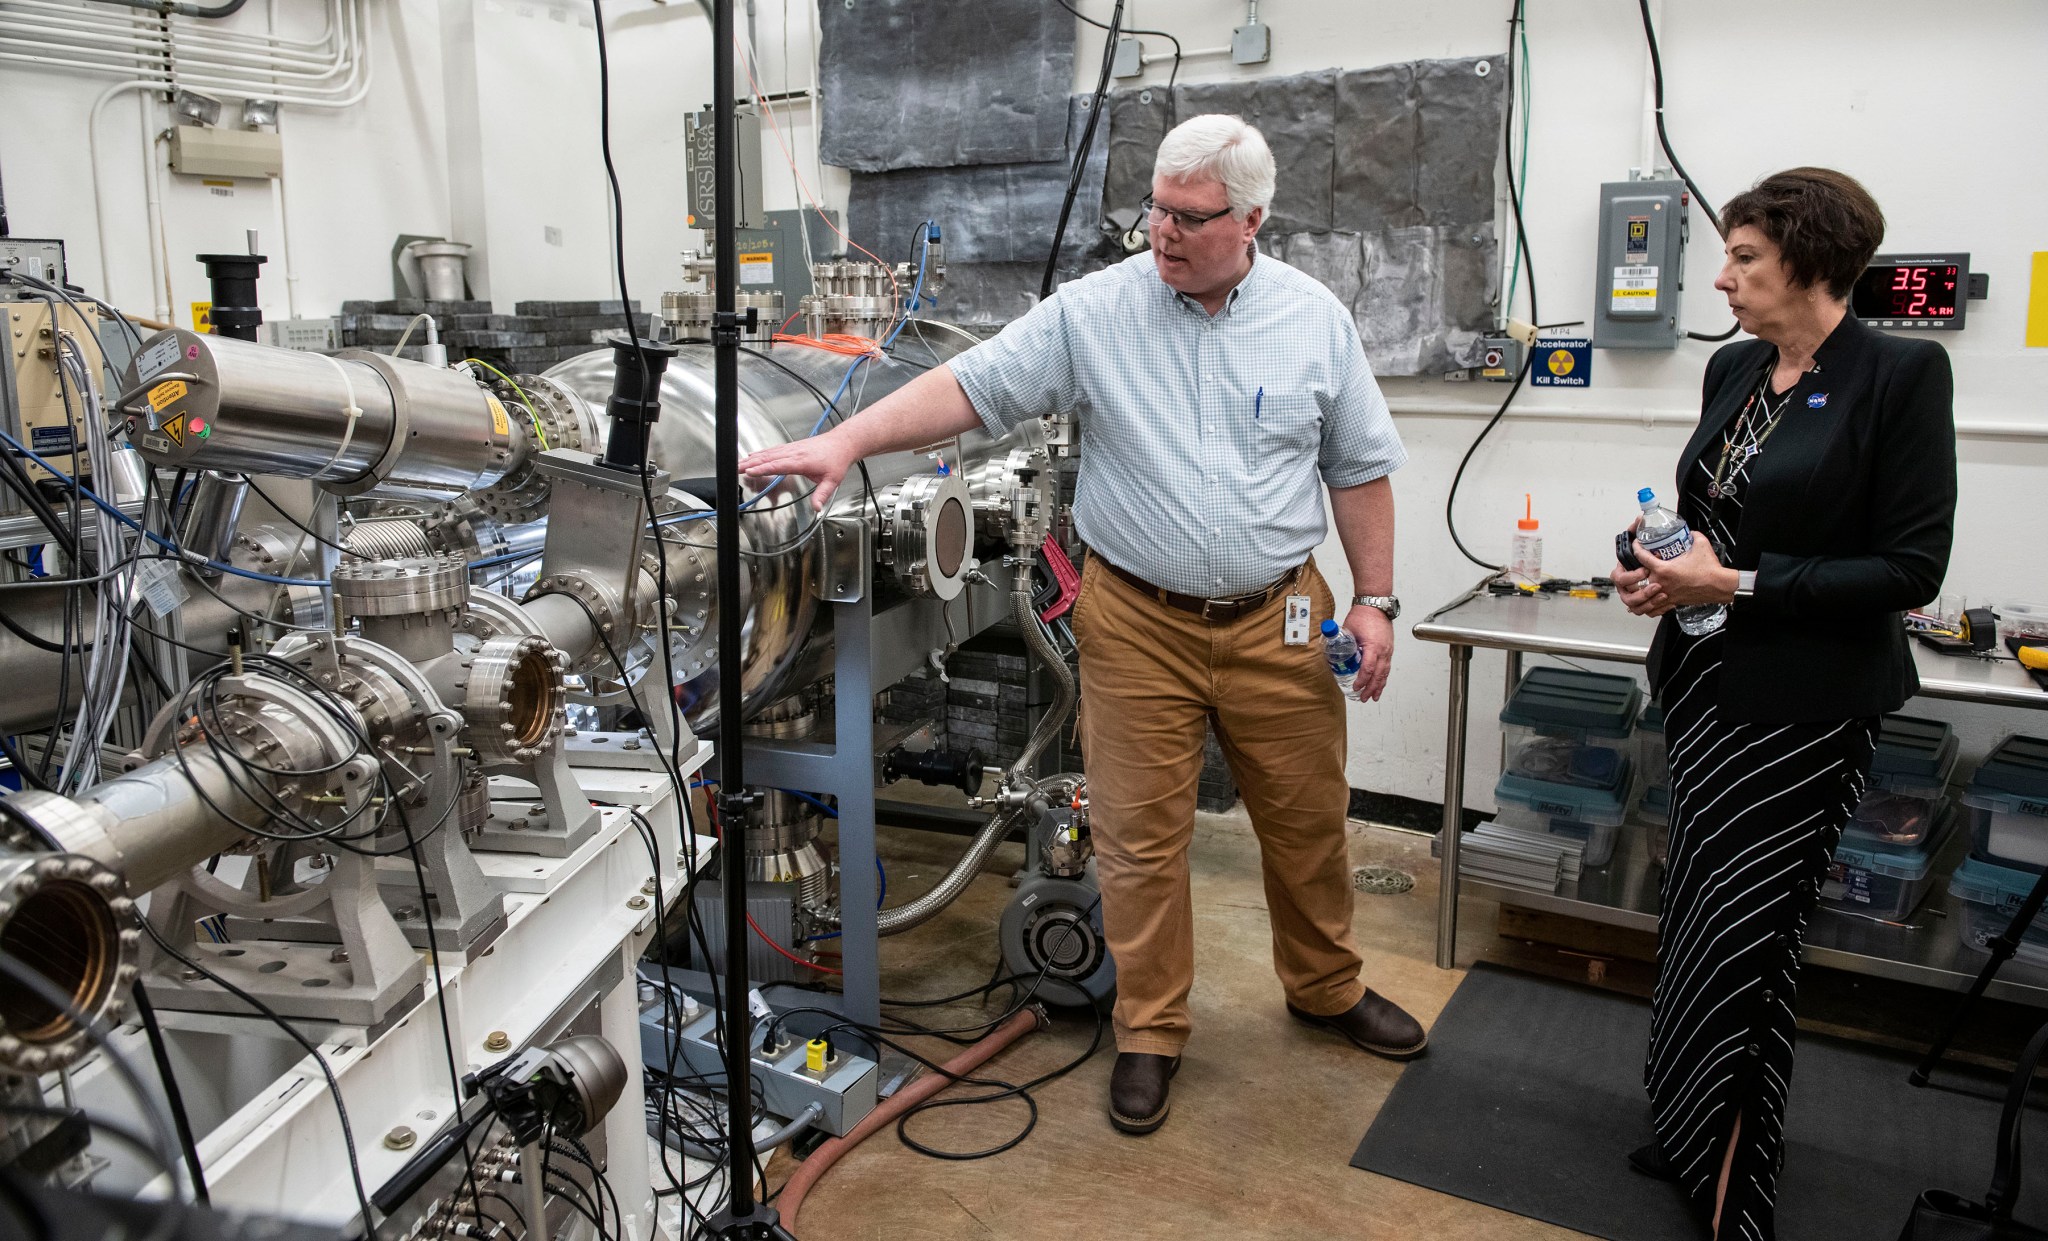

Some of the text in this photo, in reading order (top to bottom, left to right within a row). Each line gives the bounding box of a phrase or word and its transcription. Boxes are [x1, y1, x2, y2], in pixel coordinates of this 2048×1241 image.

[697, 123, 709, 162] RGA
[699, 170, 715, 212] SRS
[1939, 307, 1954, 315] RH
[1535, 340, 1588, 348] Accelerator
[1536, 376, 1584, 385] Kill Switch
[156, 389, 180, 407] Attention
[1659, 541, 1681, 555] DEER
[1662, 546, 1684, 560] PARK
